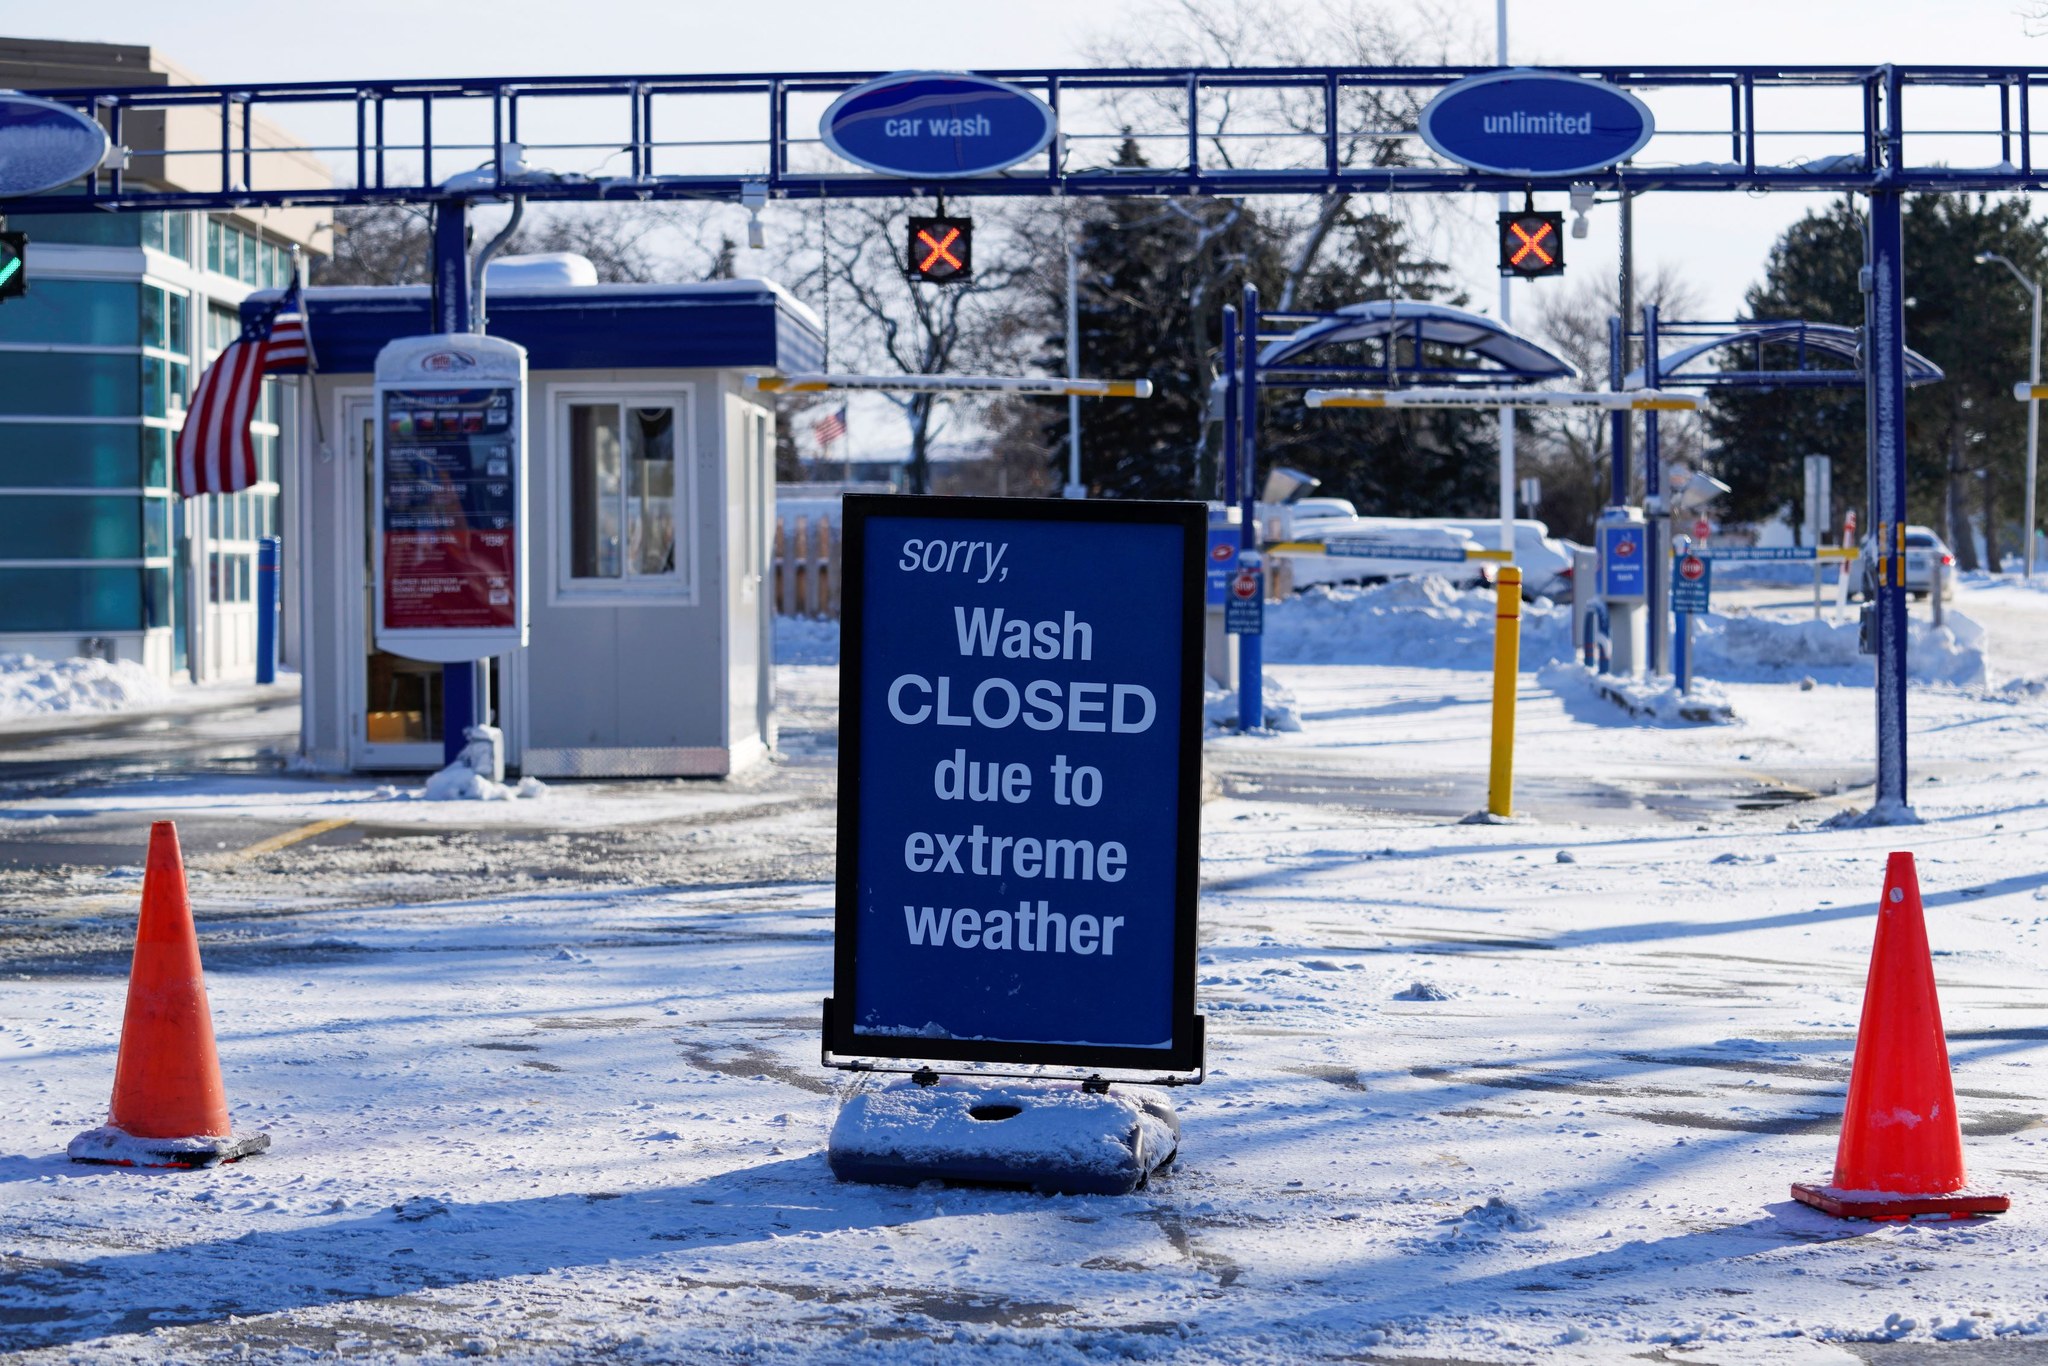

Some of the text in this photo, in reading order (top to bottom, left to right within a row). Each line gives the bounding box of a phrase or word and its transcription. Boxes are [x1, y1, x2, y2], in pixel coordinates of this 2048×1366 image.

[886, 115, 991, 138] car wash
[1485, 112, 1592, 135] unlimited
[899, 539, 1010, 585] sorry,
[1236, 582, 1256, 591] STOP
[1682, 562, 1703, 572] STOP
[954, 607, 1094, 662] Wash
[888, 674, 1158, 735] CLOSED
[935, 749, 1104, 808] due to
[905, 825, 1129, 884] extreme
[904, 901, 1126, 957] weather
